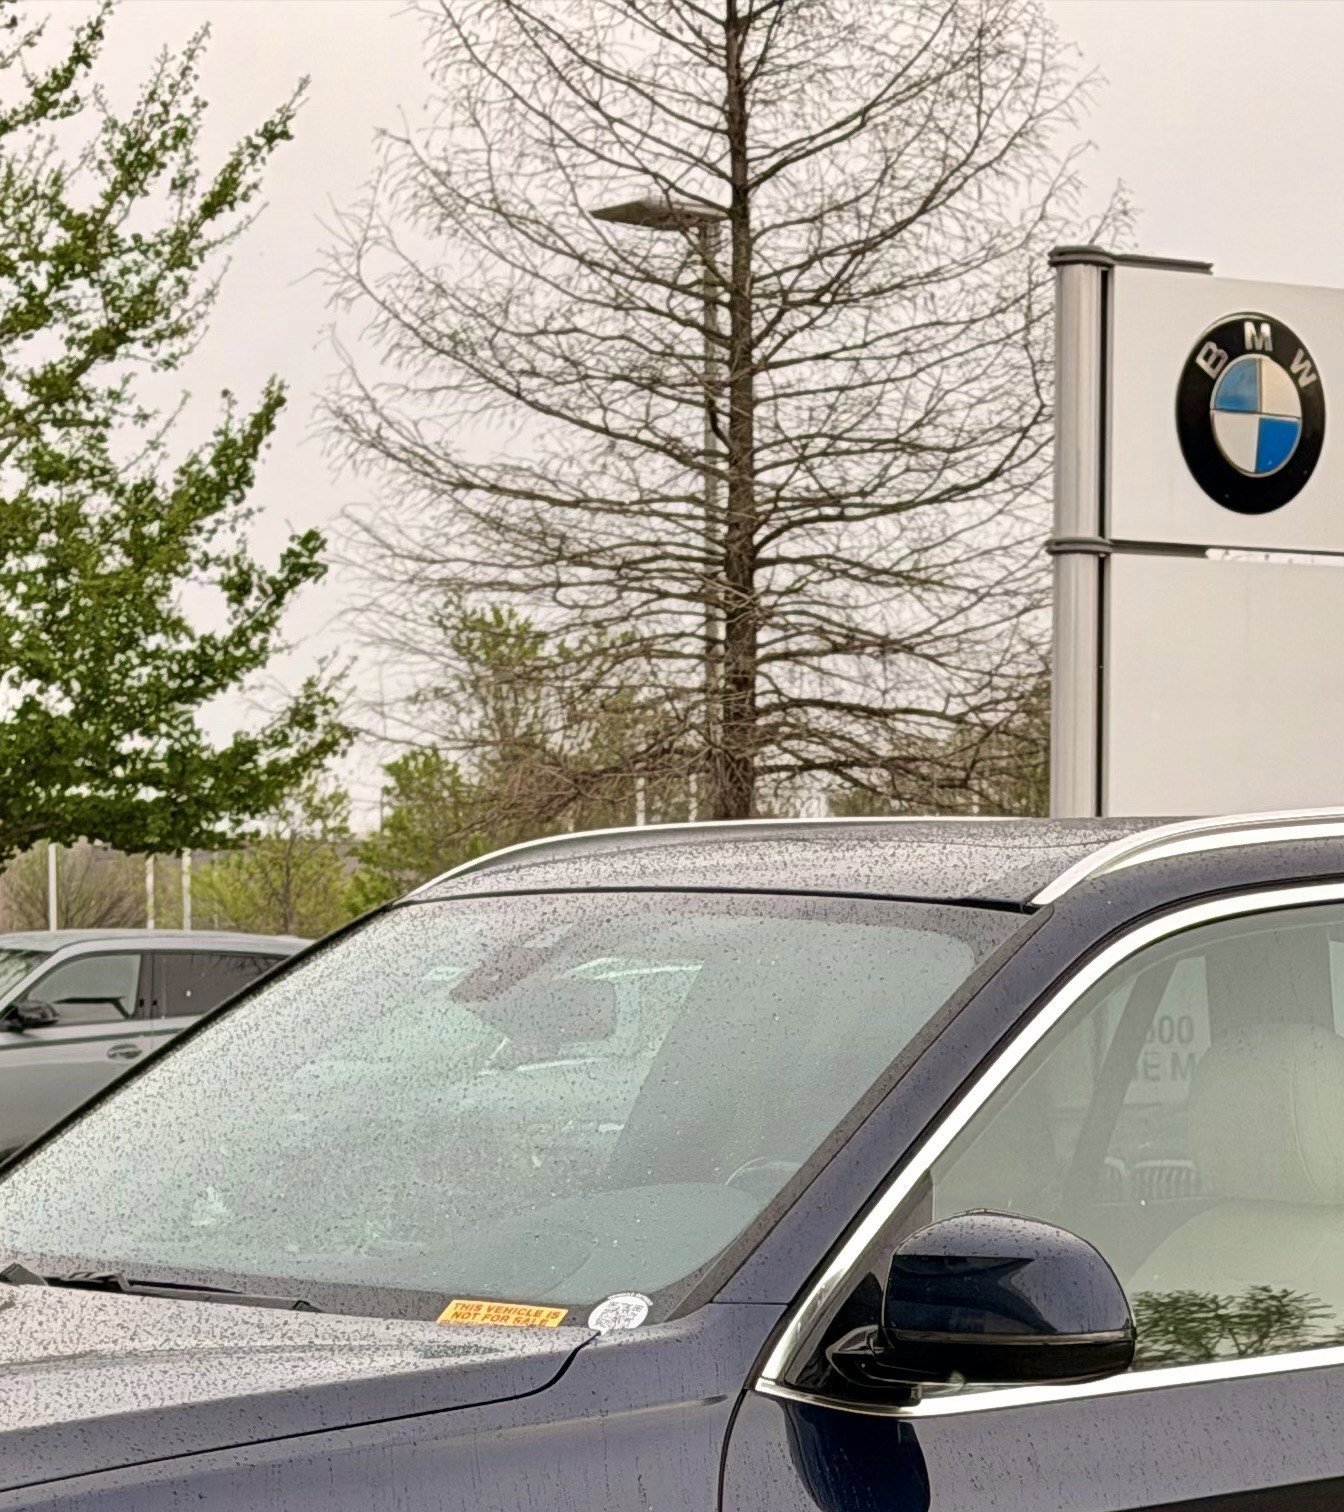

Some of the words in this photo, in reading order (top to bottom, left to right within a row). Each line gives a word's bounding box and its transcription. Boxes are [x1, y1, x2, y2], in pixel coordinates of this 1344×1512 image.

[1196, 321, 1317, 388] BMW
[451, 1311, 480, 1320] NOT
[481, 1314, 510, 1323] FOR
[453, 1302, 483, 1312] THIS
[486, 1305, 543, 1317] VEHICLE
[545, 1311, 561, 1319] IS
